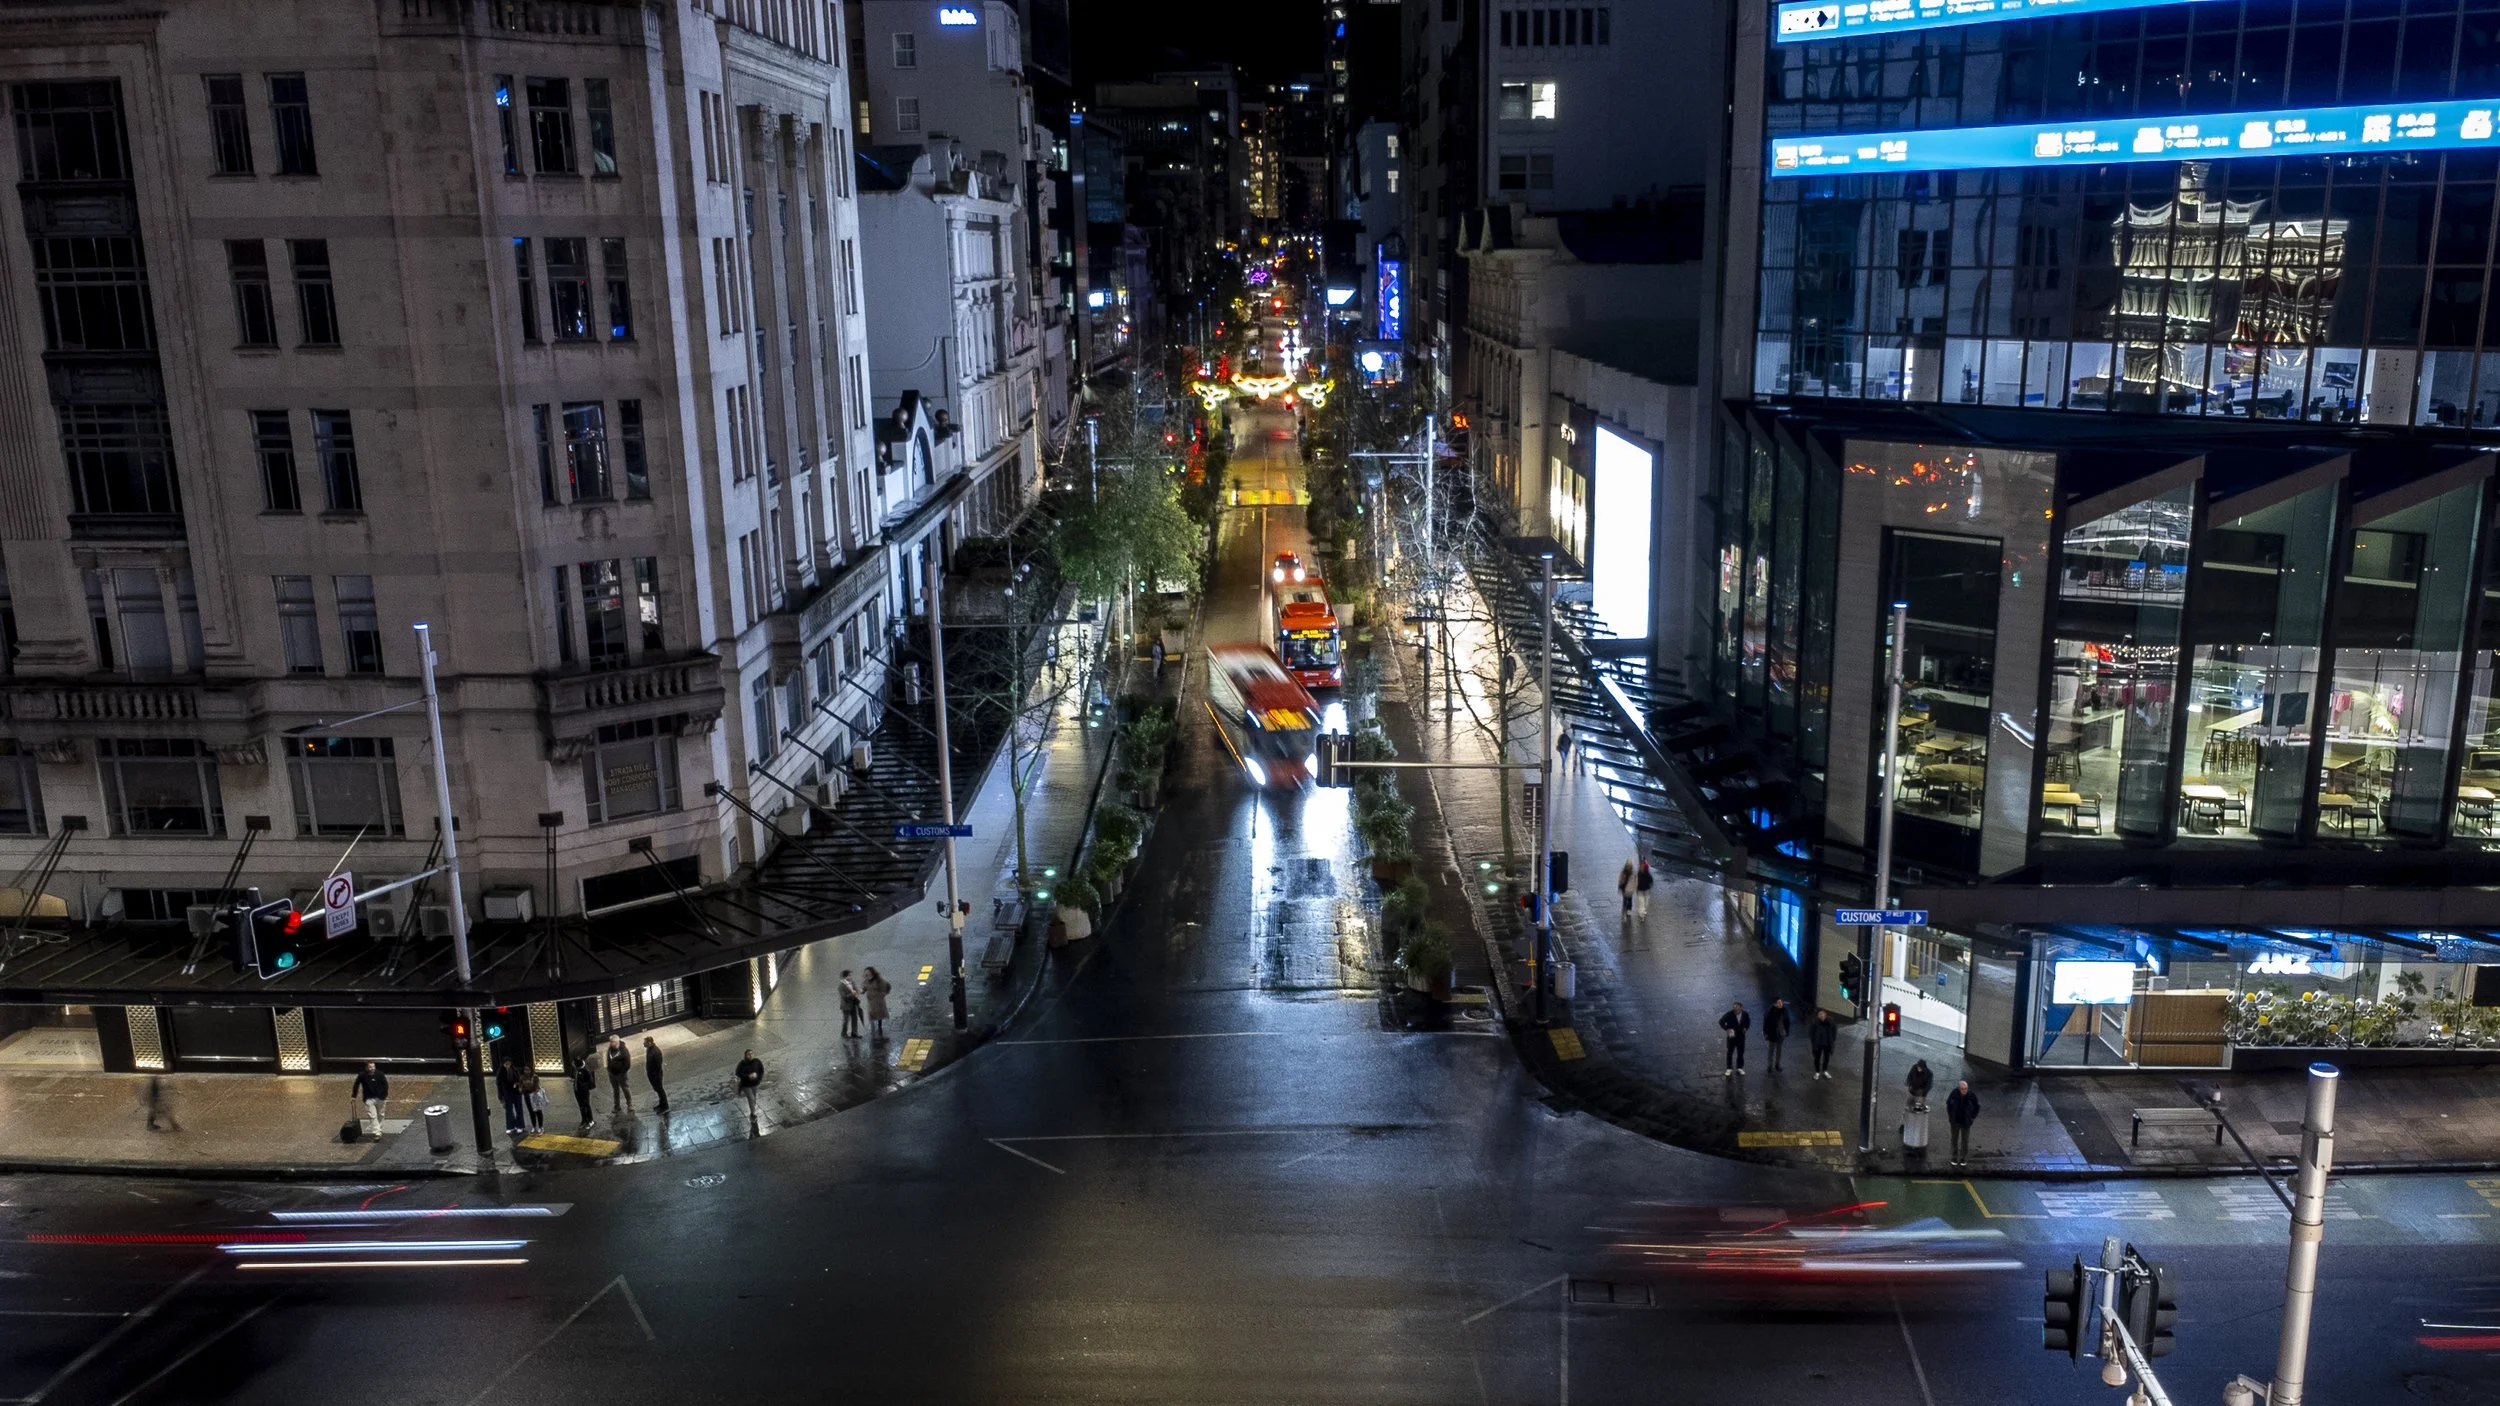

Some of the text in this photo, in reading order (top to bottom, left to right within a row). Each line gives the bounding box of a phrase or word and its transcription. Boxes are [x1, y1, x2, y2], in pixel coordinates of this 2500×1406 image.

[610, 764, 650, 777] STRATA TITLE
[610, 780, 652, 794] MANAGEMENT
[915, 826, 951, 836] CUSTOMS
[1841, 911, 1882, 922] CUSTOMS
[2247, 953, 2311, 975] ANZ
